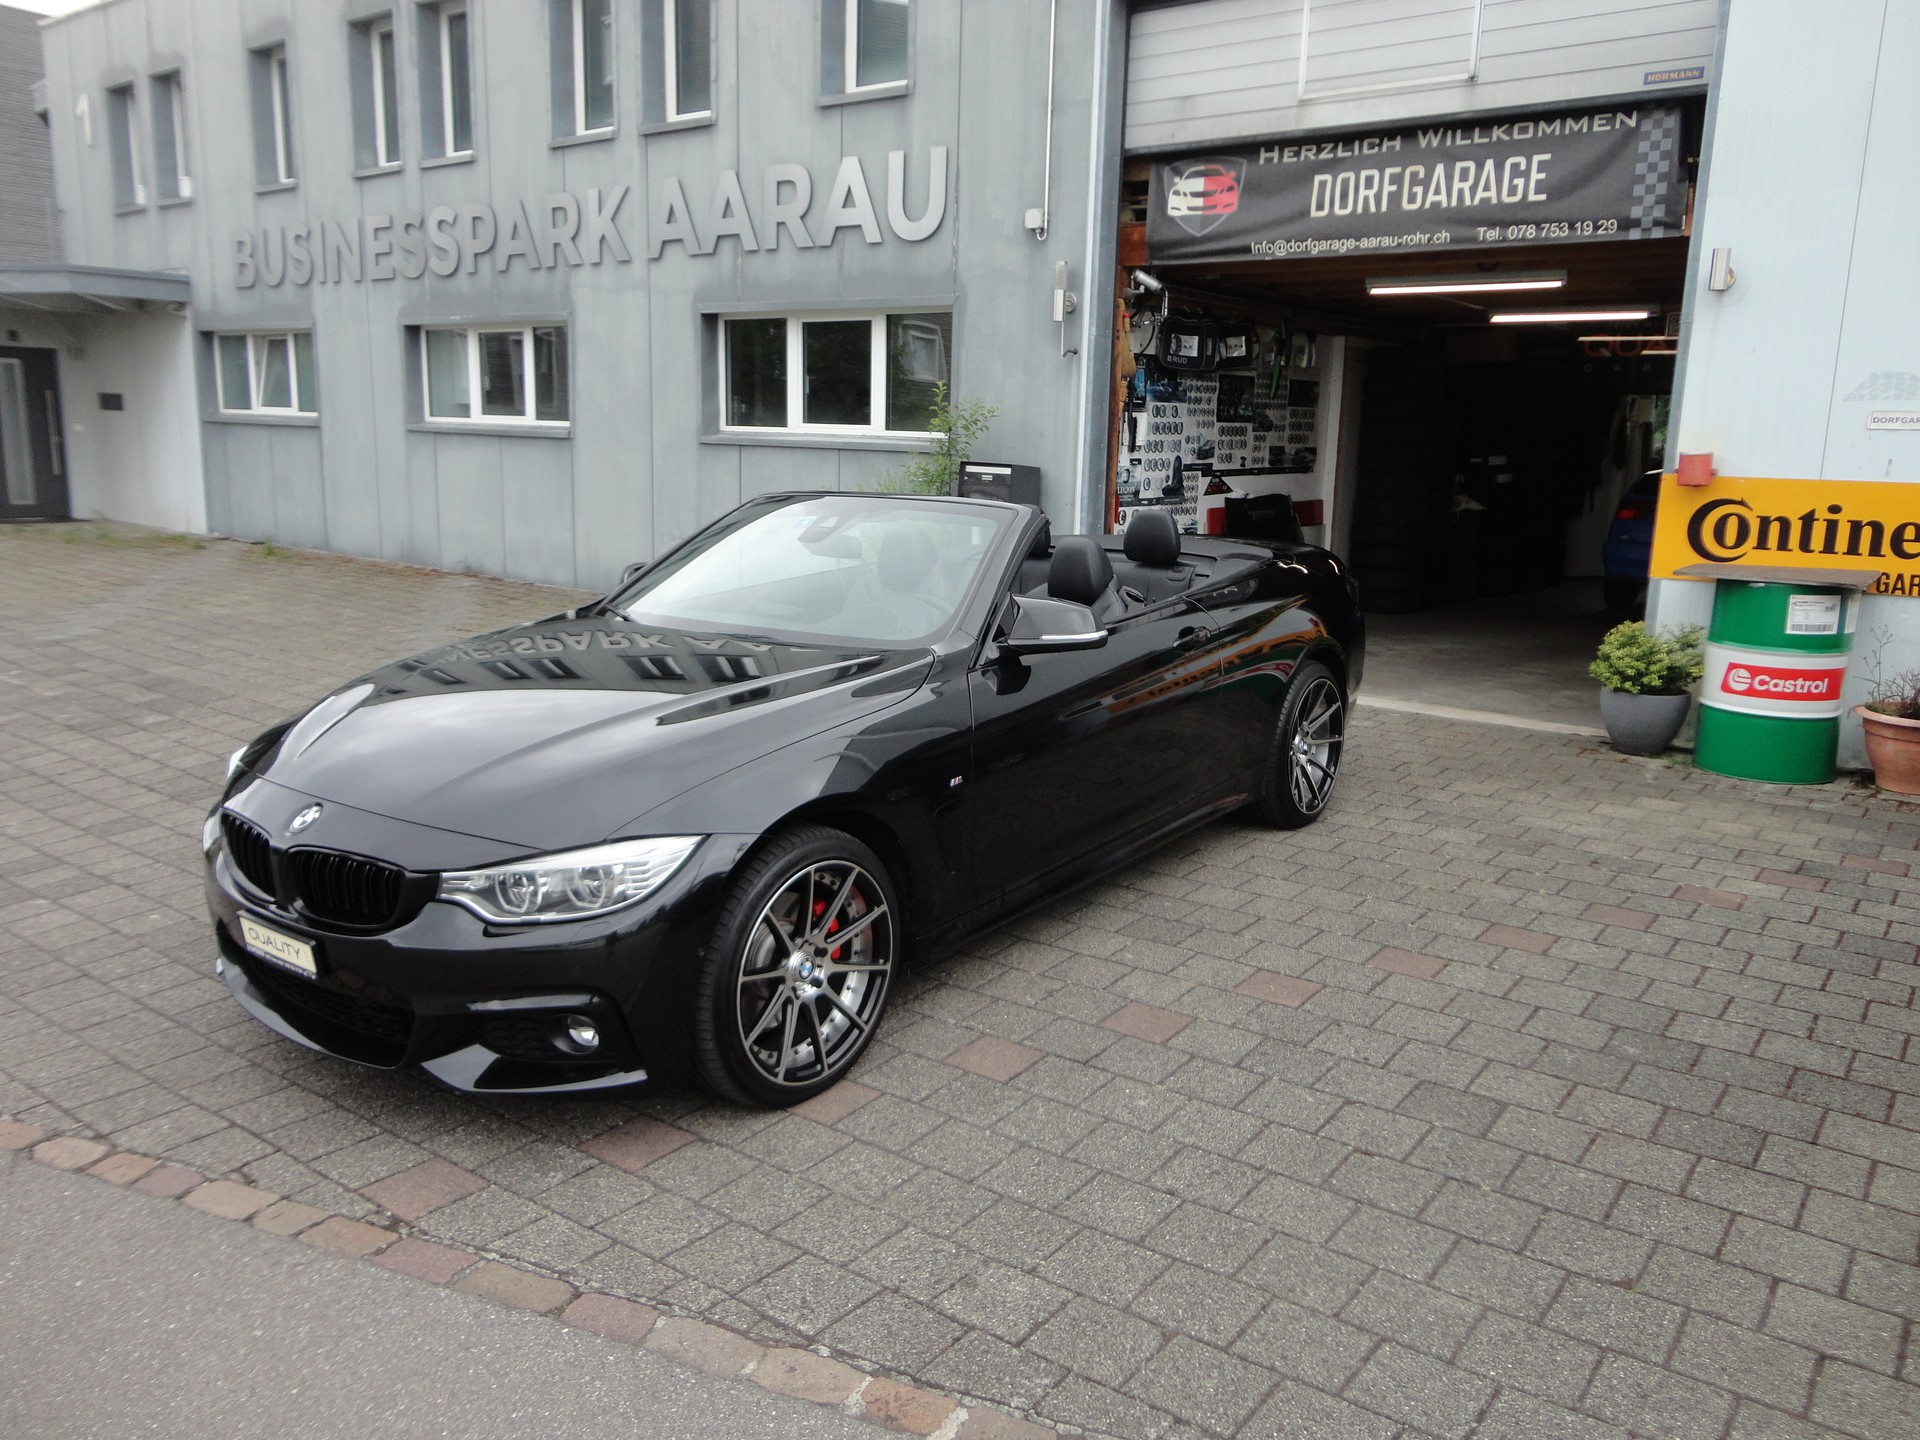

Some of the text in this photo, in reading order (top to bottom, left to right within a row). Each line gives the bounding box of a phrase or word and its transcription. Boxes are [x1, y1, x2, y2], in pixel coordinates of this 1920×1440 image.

[1259, 110, 1639, 165] HERZLICH WILLKOMMEN
[1310, 152, 1552, 218] DORFGARAGE
[233, 145, 949, 289] BUSINESSPARK AARAU
[1477, 218, 1618, 242] Tel. 078 753 19 29
[1251, 229, 1451, 256] Info@dorfgarage-aarau-rohr.ch
[1753, 674, 1829, 694] Castrol
